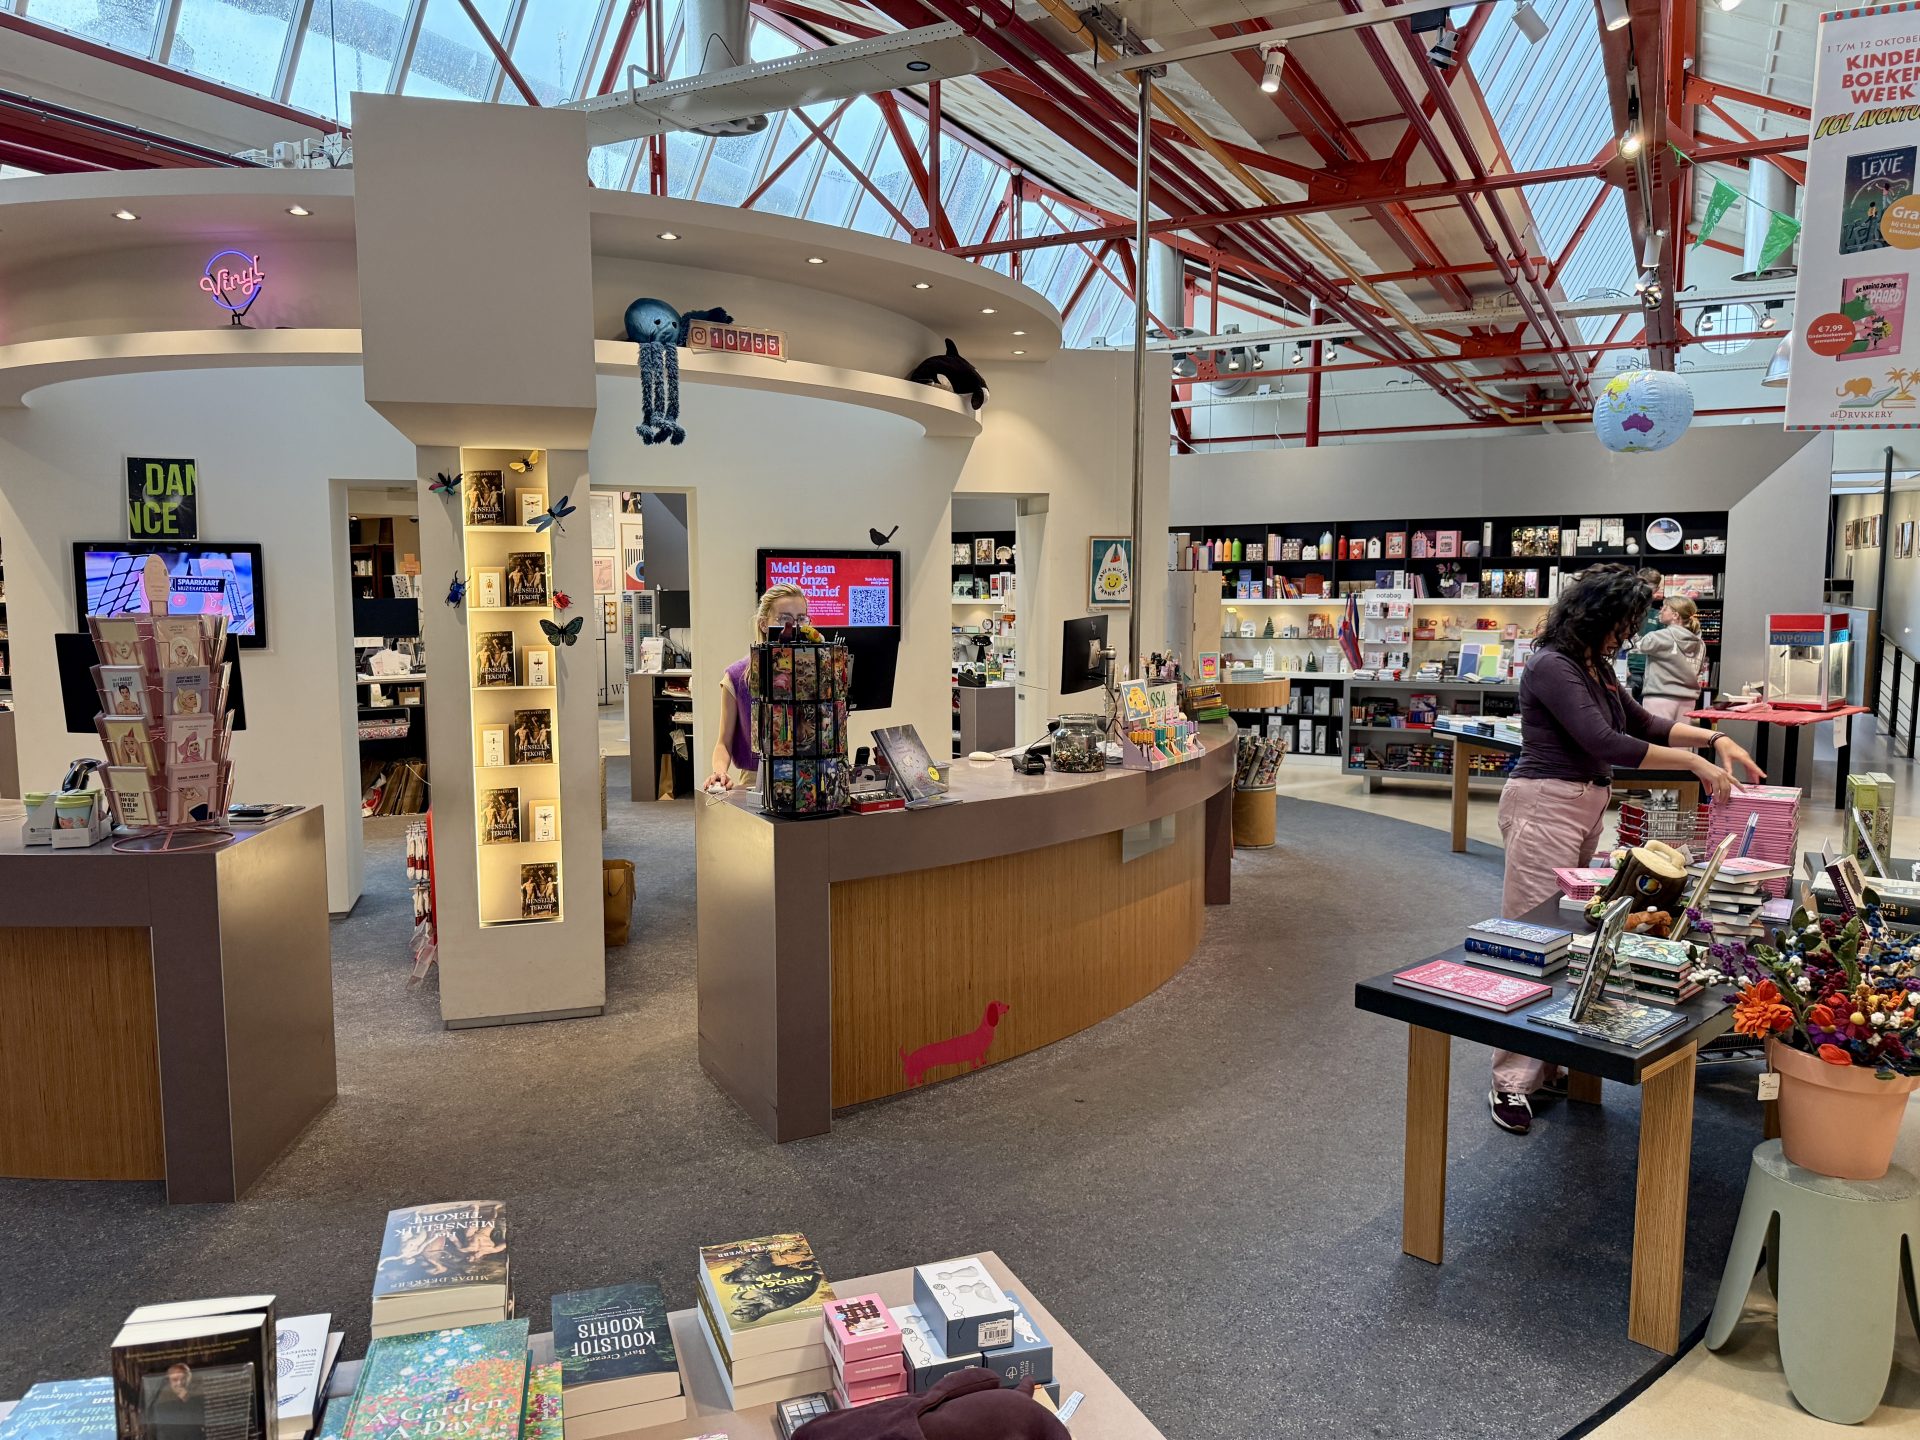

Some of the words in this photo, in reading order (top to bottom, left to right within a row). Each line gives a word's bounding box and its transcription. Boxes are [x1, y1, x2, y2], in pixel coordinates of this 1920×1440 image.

[1836, 43, 1855, 53] T/M
[1875, 35, 1920, 47] OKTOBE
[1851, 82, 1916, 104] WEEK
[1814, 112, 1854, 140] VOL
[1861, 156, 1904, 180] LEXIE
[1892, 206, 1920, 220] Gra
[712, 331, 776, 351] 10755
[146, 462, 196, 496] DAN
[129, 501, 179, 534] NCE
[771, 562, 800, 574] Meld
[802, 562, 812, 576] je
[815, 565, 836, 574] aan
[1098, 568, 1107, 581] HAVE
[771, 576, 798, 586] voor
[800, 576, 828, 585] onze
[1098, 584, 1116, 596] THANK
[1118, 584, 1128, 594] YOU
[1841, 886, 1854, 904] BEAUTY
[1849, 904, 1856, 913] OF
[411, 1211, 482, 1224] TEKORT
[395, 1220, 496, 1237] MENSELIJK
[434, 1231, 456, 1239] Het
[390, 1278, 447, 1288] DEKKERS
[730, 1275, 813, 1294] ARROGANTE
[756, 1272, 782, 1282] AAP
[578, 1316, 644, 1339] KOORTS
[570, 1331, 656, 1357] KOOLSTOF
[624, 1348, 646, 1358] Bart
[366, 1412, 388, 1426] A
[400, 1397, 508, 1420] Garden
[387, 1425, 410, 1440] A
[425, 1418, 476, 1434] Day
